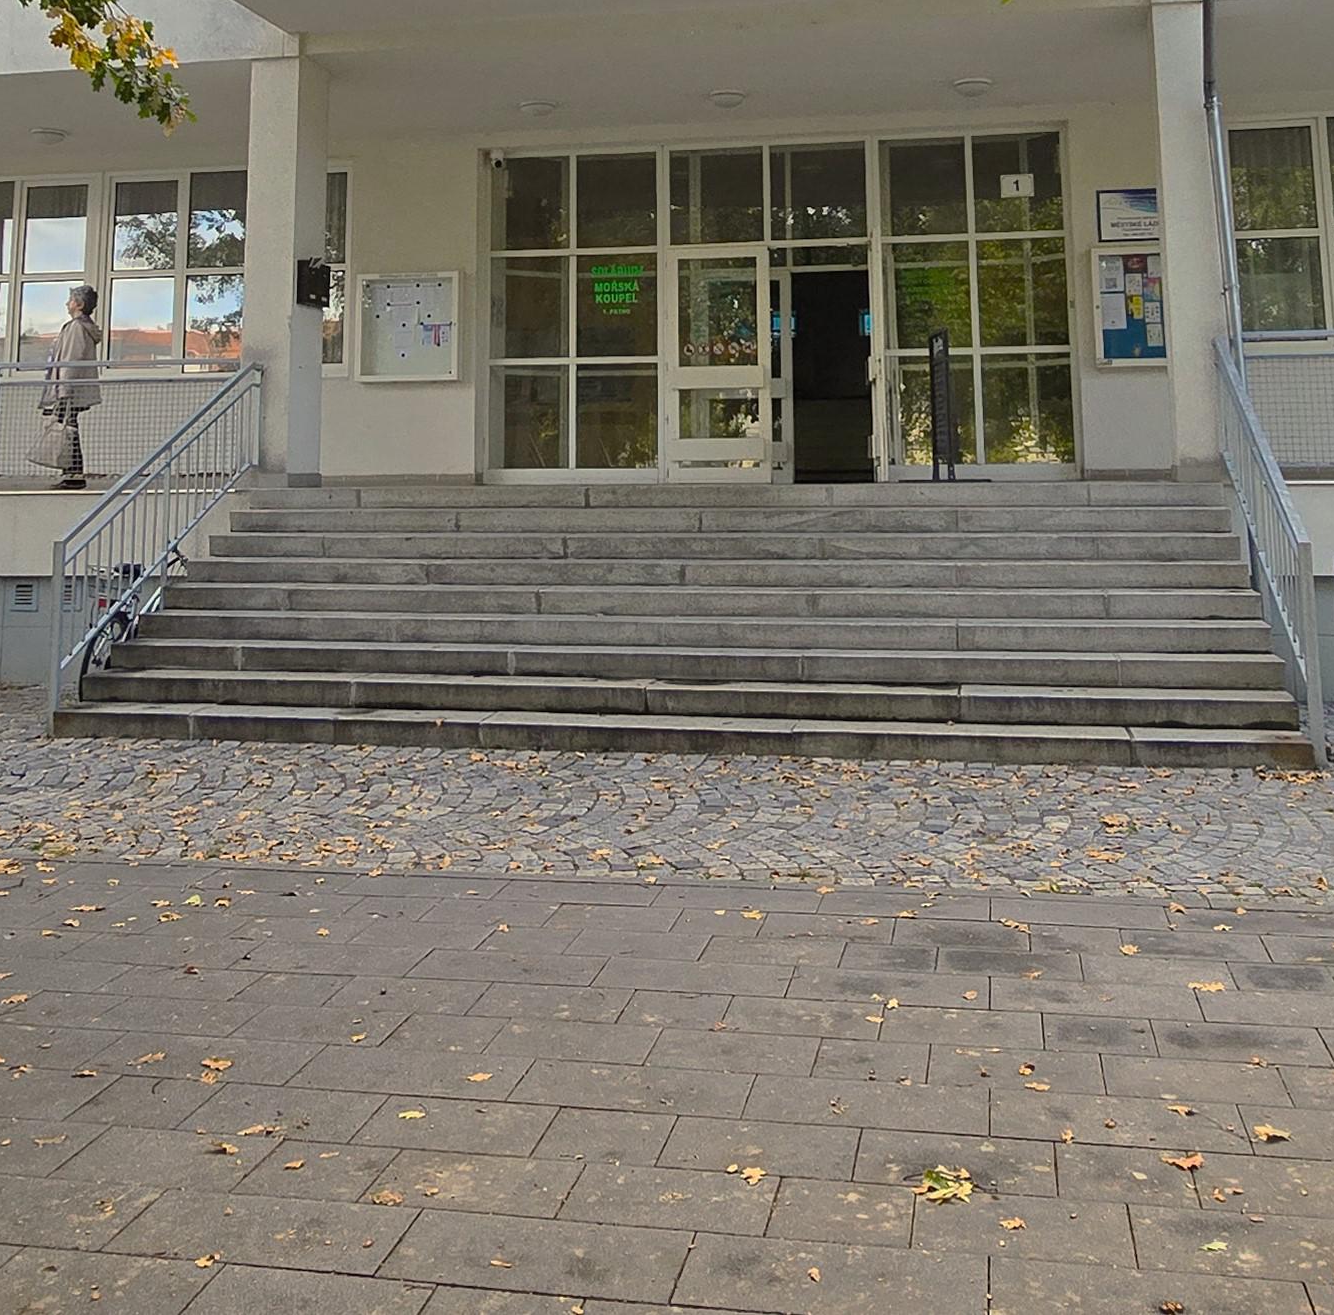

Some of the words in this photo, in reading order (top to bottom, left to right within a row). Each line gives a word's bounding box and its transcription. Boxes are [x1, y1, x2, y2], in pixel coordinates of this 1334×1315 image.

[1012, 179, 1020, 191] 1
[594, 279, 640, 292] MOŘSKÁ
[595, 293, 638, 304] KOUPEL
